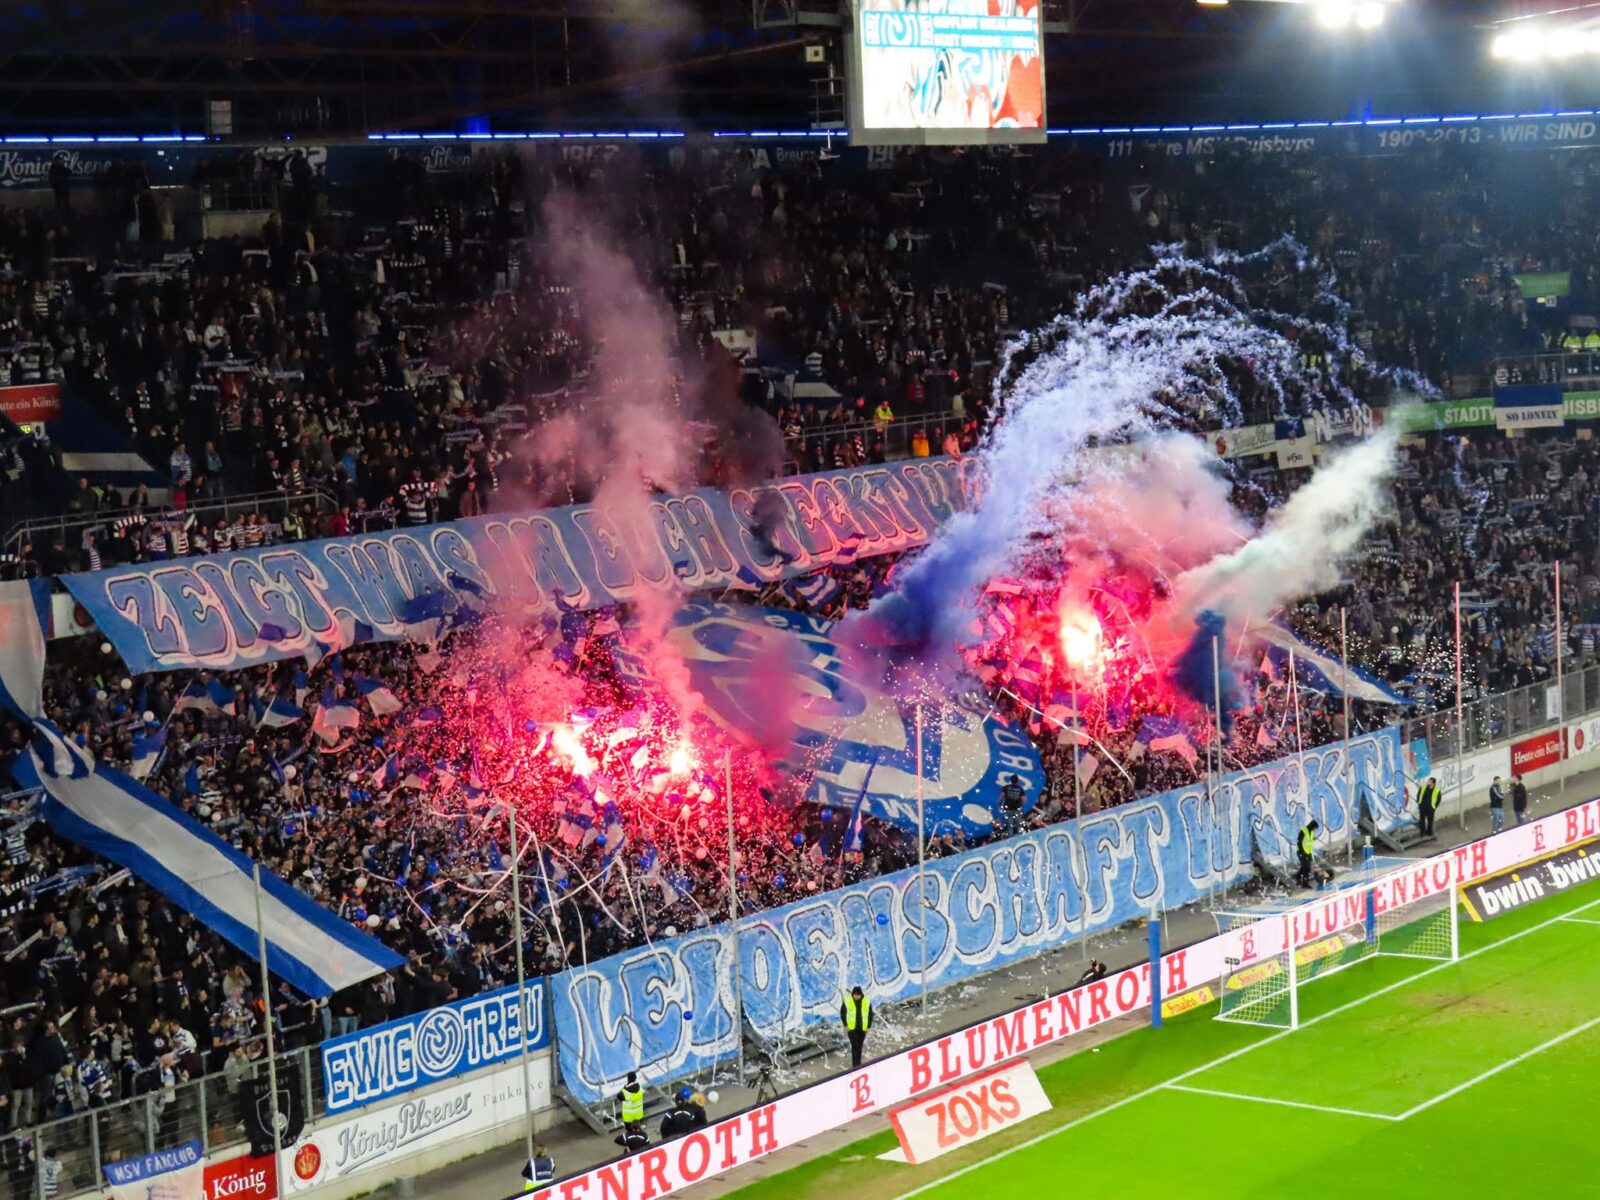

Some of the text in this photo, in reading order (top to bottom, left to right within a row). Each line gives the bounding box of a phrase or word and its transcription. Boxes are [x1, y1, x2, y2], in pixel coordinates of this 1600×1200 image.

[1501, 124, 1539, 143] WIR
[1543, 121, 1596, 142] SIND
[1506, 409, 1559, 422] SO LONELY
[105, 552, 329, 666] ZEIGT
[1478, 874, 1545, 915] bwin
[1167, 996, 1197, 1014] Sinalco
[324, 983, 544, 1109] EWIG TREU
[336, 1123, 399, 1167] König
[399, 1091, 473, 1143] Pilsener
[483, 1080, 544, 1107] Fankuve
[925, 1078, 1020, 1149] ZOXS
[114, 1162, 141, 1182] MSV
[213, 1168, 266, 1200] König
